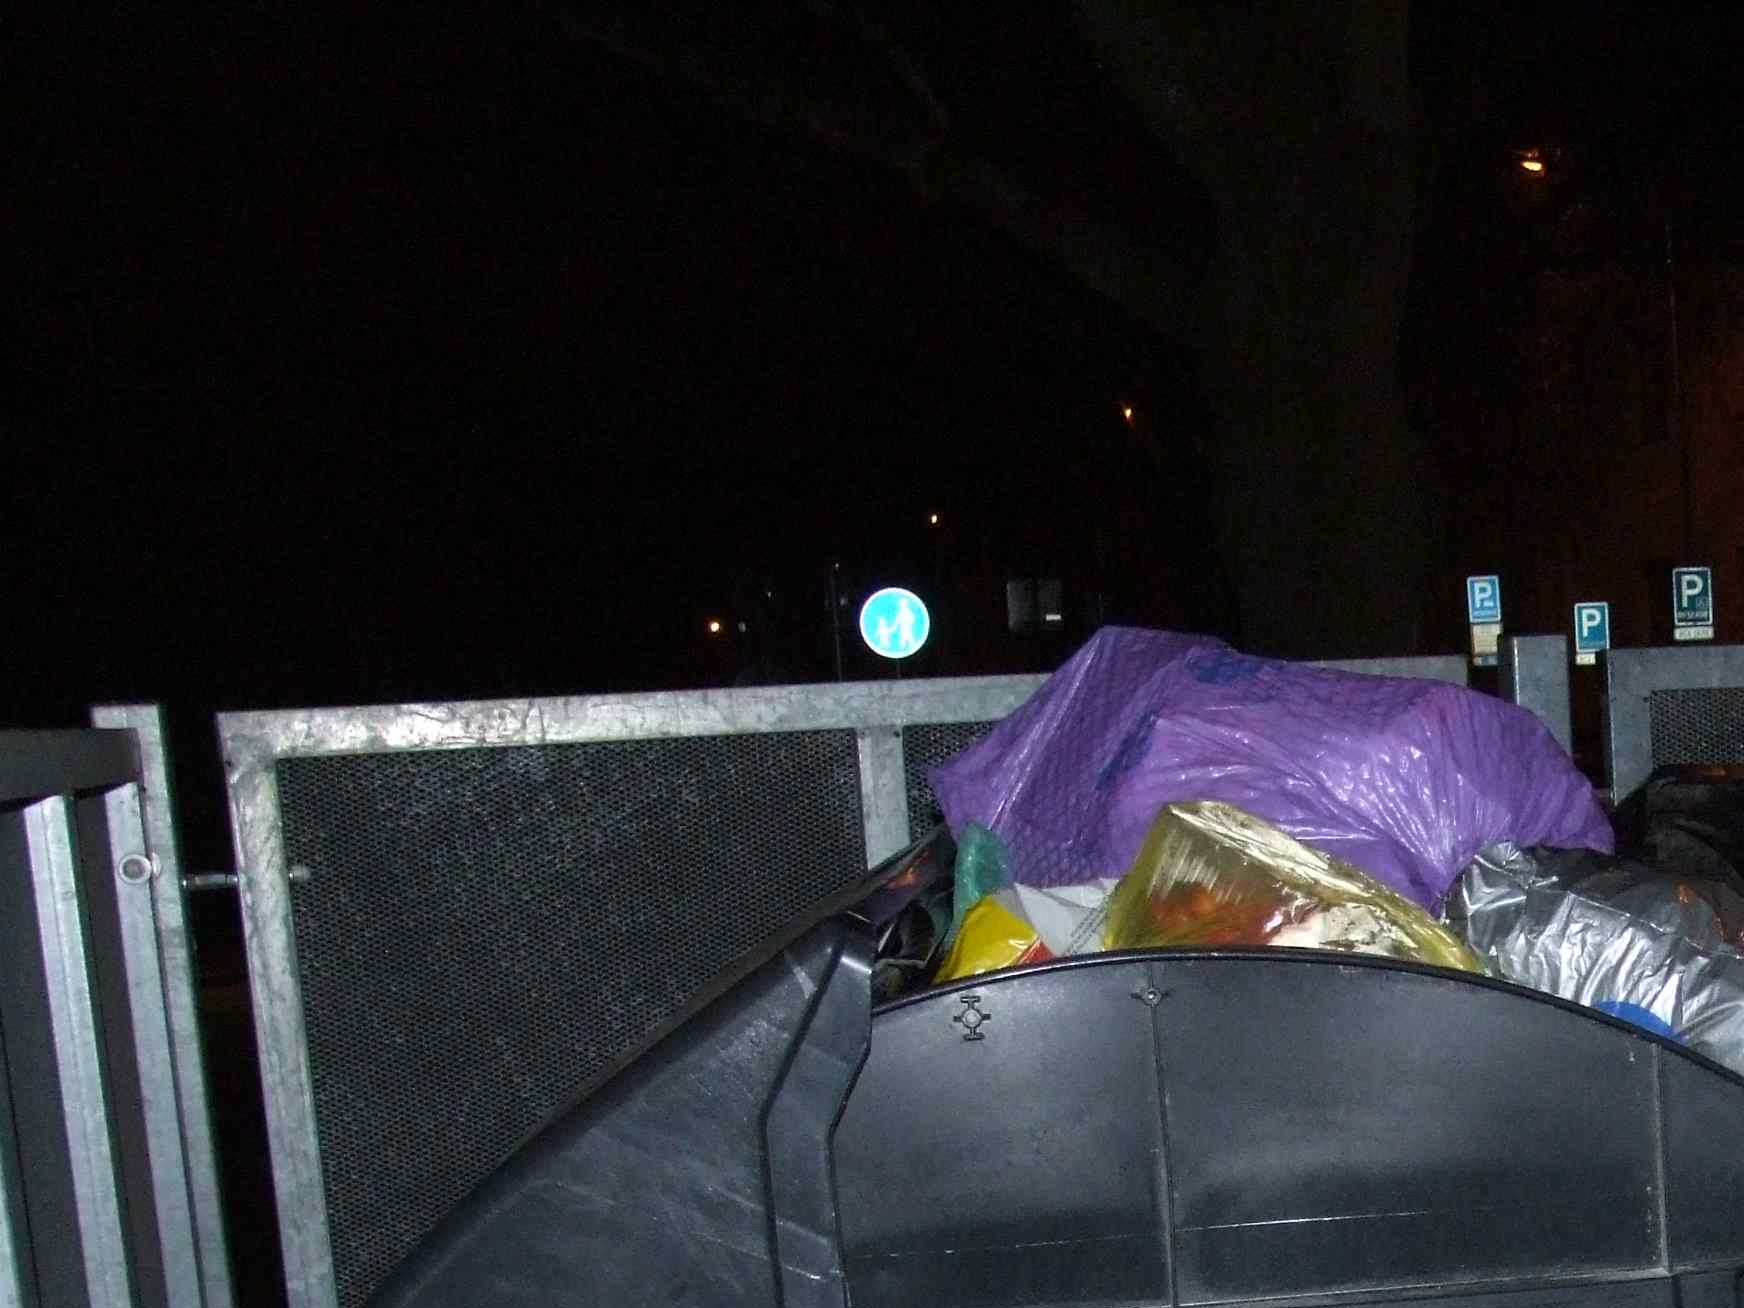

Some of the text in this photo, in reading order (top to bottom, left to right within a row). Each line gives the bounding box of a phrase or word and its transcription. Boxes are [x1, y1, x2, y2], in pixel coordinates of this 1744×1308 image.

[1473, 581, 1493, 608] P
[1681, 574, 1704, 608] P
[1582, 607, 1601, 638] P
